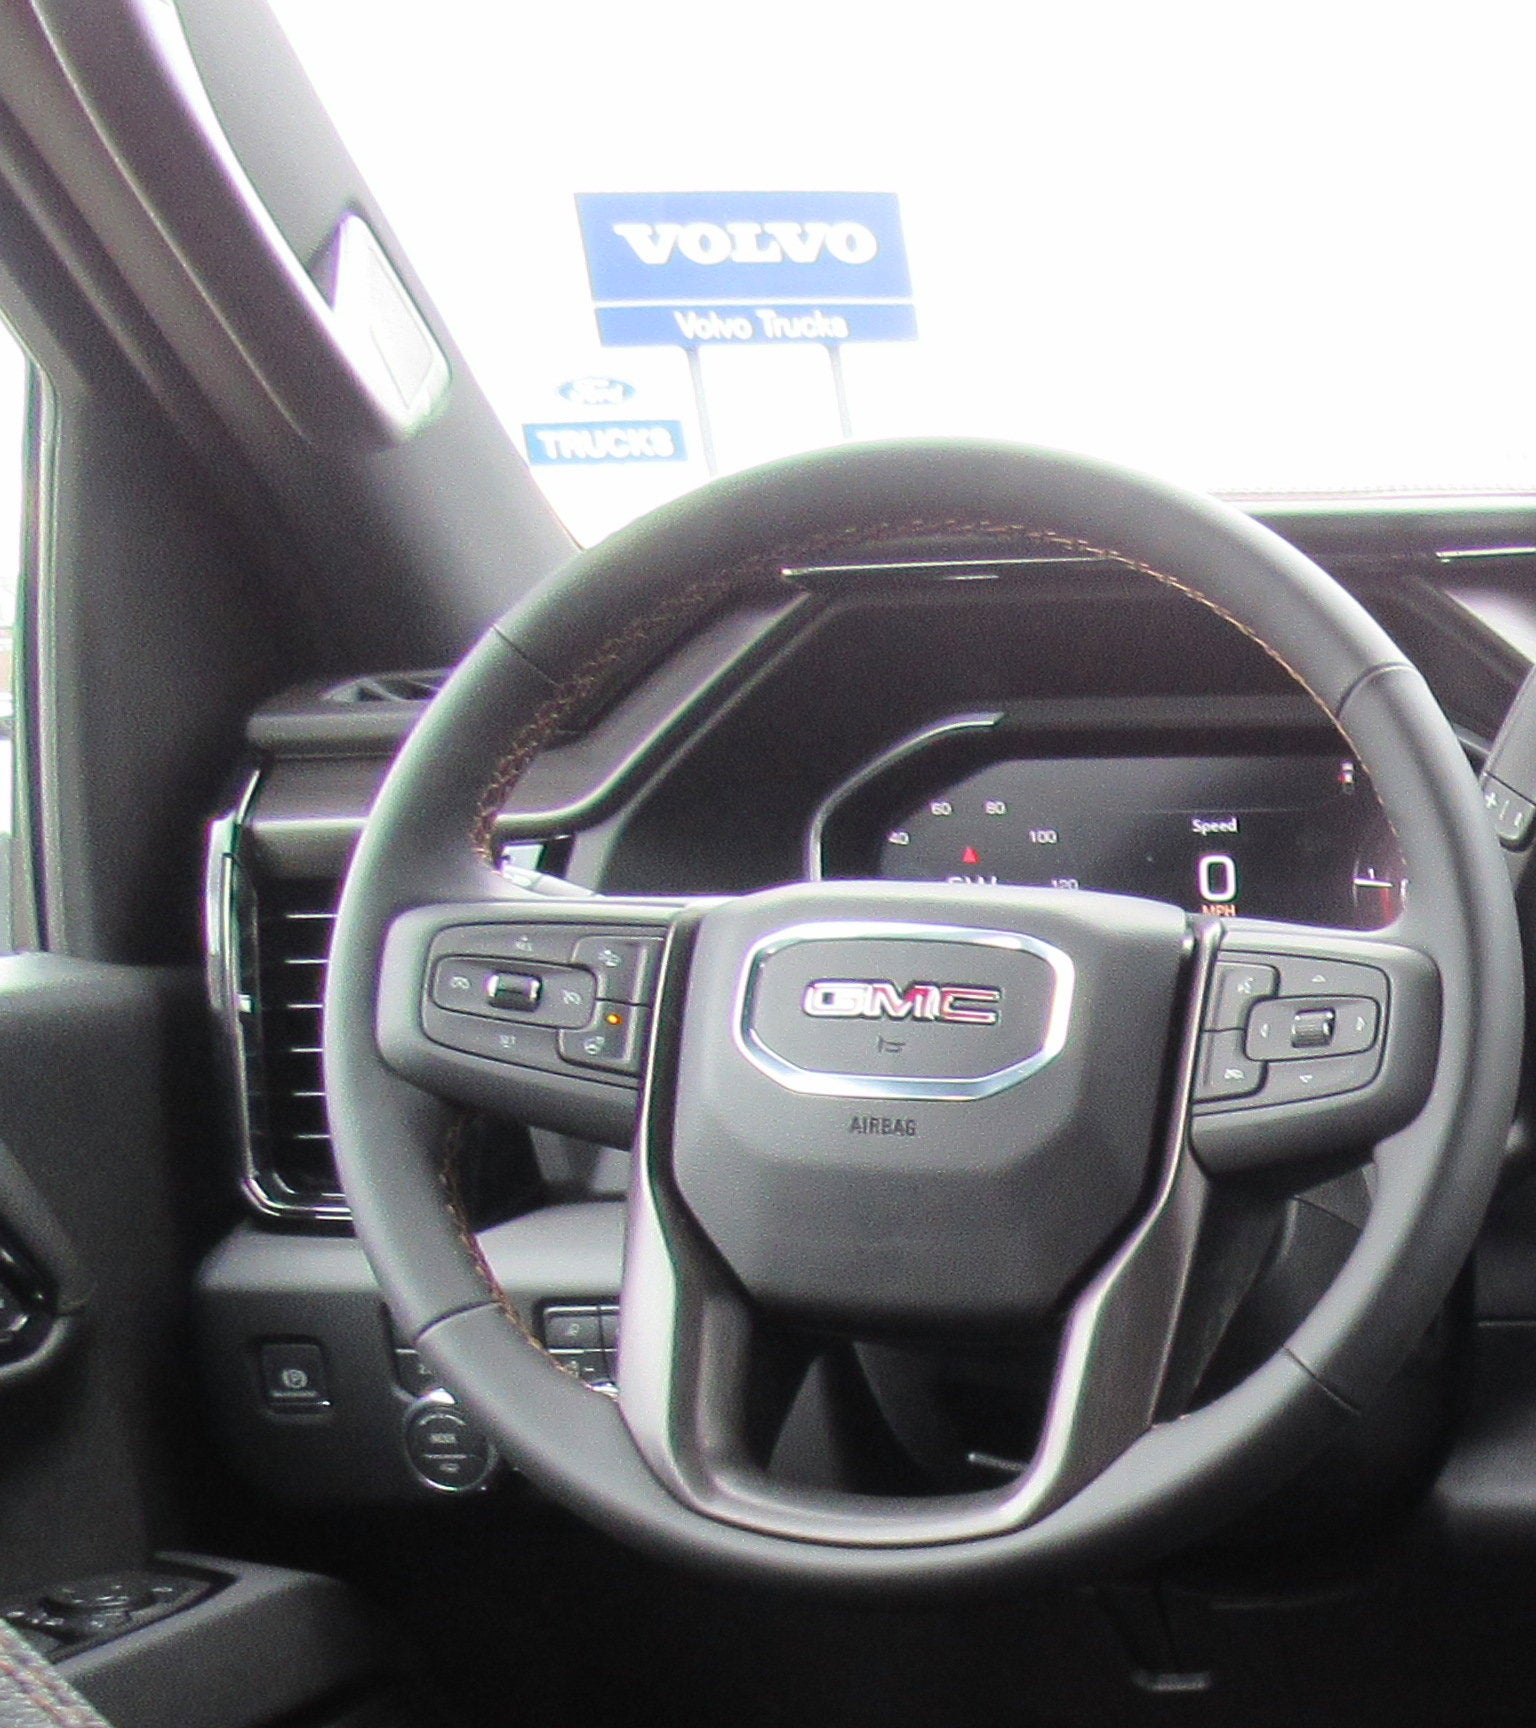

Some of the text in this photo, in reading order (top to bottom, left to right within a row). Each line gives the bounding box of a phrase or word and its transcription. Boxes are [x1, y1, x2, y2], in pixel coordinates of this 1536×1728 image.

[613, 222, 879, 265] VOLVO
[674, 309, 849, 341] Volvo Trucks
[535, 428, 675, 459] TRUCKS
[931, 801, 952, 816] 60
[985, 801, 1006, 816] 80
[1029, 830, 1057, 845] 100
[1191, 817, 1238, 836] Speed
[888, 830, 909, 846] 40
[1199, 853, 1237, 902] 0
[802, 979, 1002, 1025] GMC
[850, 1115, 917, 1137] AIRBAG
